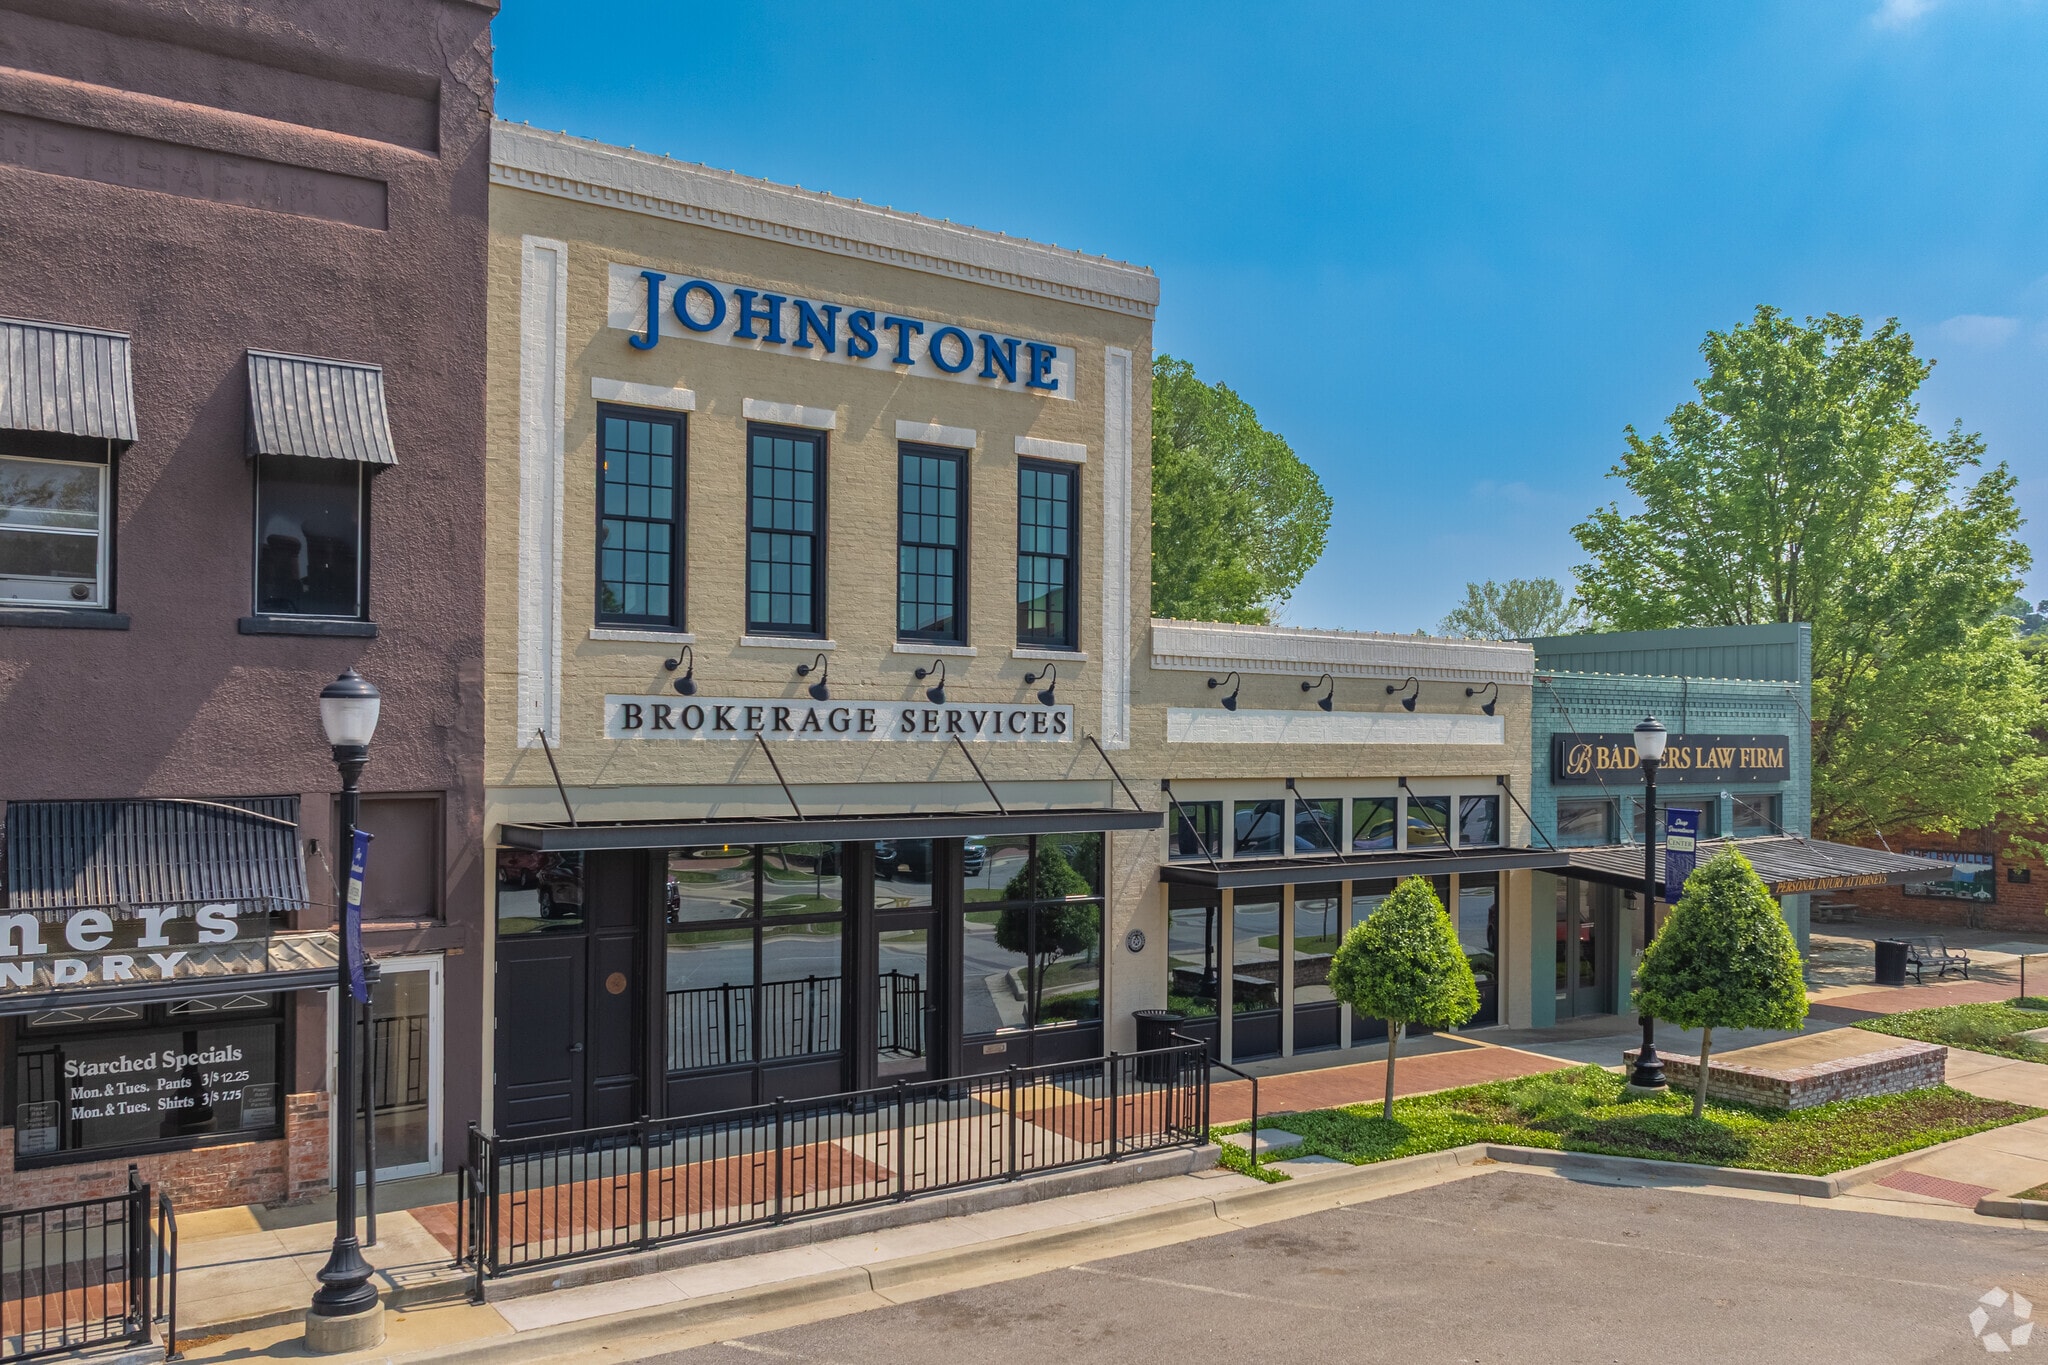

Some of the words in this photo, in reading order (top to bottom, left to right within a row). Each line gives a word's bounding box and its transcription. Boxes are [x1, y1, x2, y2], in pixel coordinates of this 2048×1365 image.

[629, 271, 1059, 391] JOHNSTONE
[621, 703, 877, 732] BROKERAGE
[902, 709, 1067, 734] SERVICES
[1597, 746, 1691, 770] BADERS
[1695, 747, 1736, 769] LAW
[1739, 747, 1784, 769] FIRM
[1776, 880, 1816, 893] PERSONAL
[1817, 878, 1844, 891] INJURY
[1844, 874, 1887, 888] ATTORNEYS
[0, 904, 239, 956] ners
[64, 1052, 157, 1078] Starched
[162, 1045, 243, 1072] Specials
[70, 1087, 103, 1100] Mon.
[104, 1083, 114, 1096] &
[116, 1082, 150, 1095] Tues.
[157, 1077, 192, 1091] Pants
[71, 1106, 104, 1120] Mon.
[105, 1103, 115, 1116] &
[116, 1101, 151, 1115] Tues.
[157, 1096, 195, 1111] Shirts
